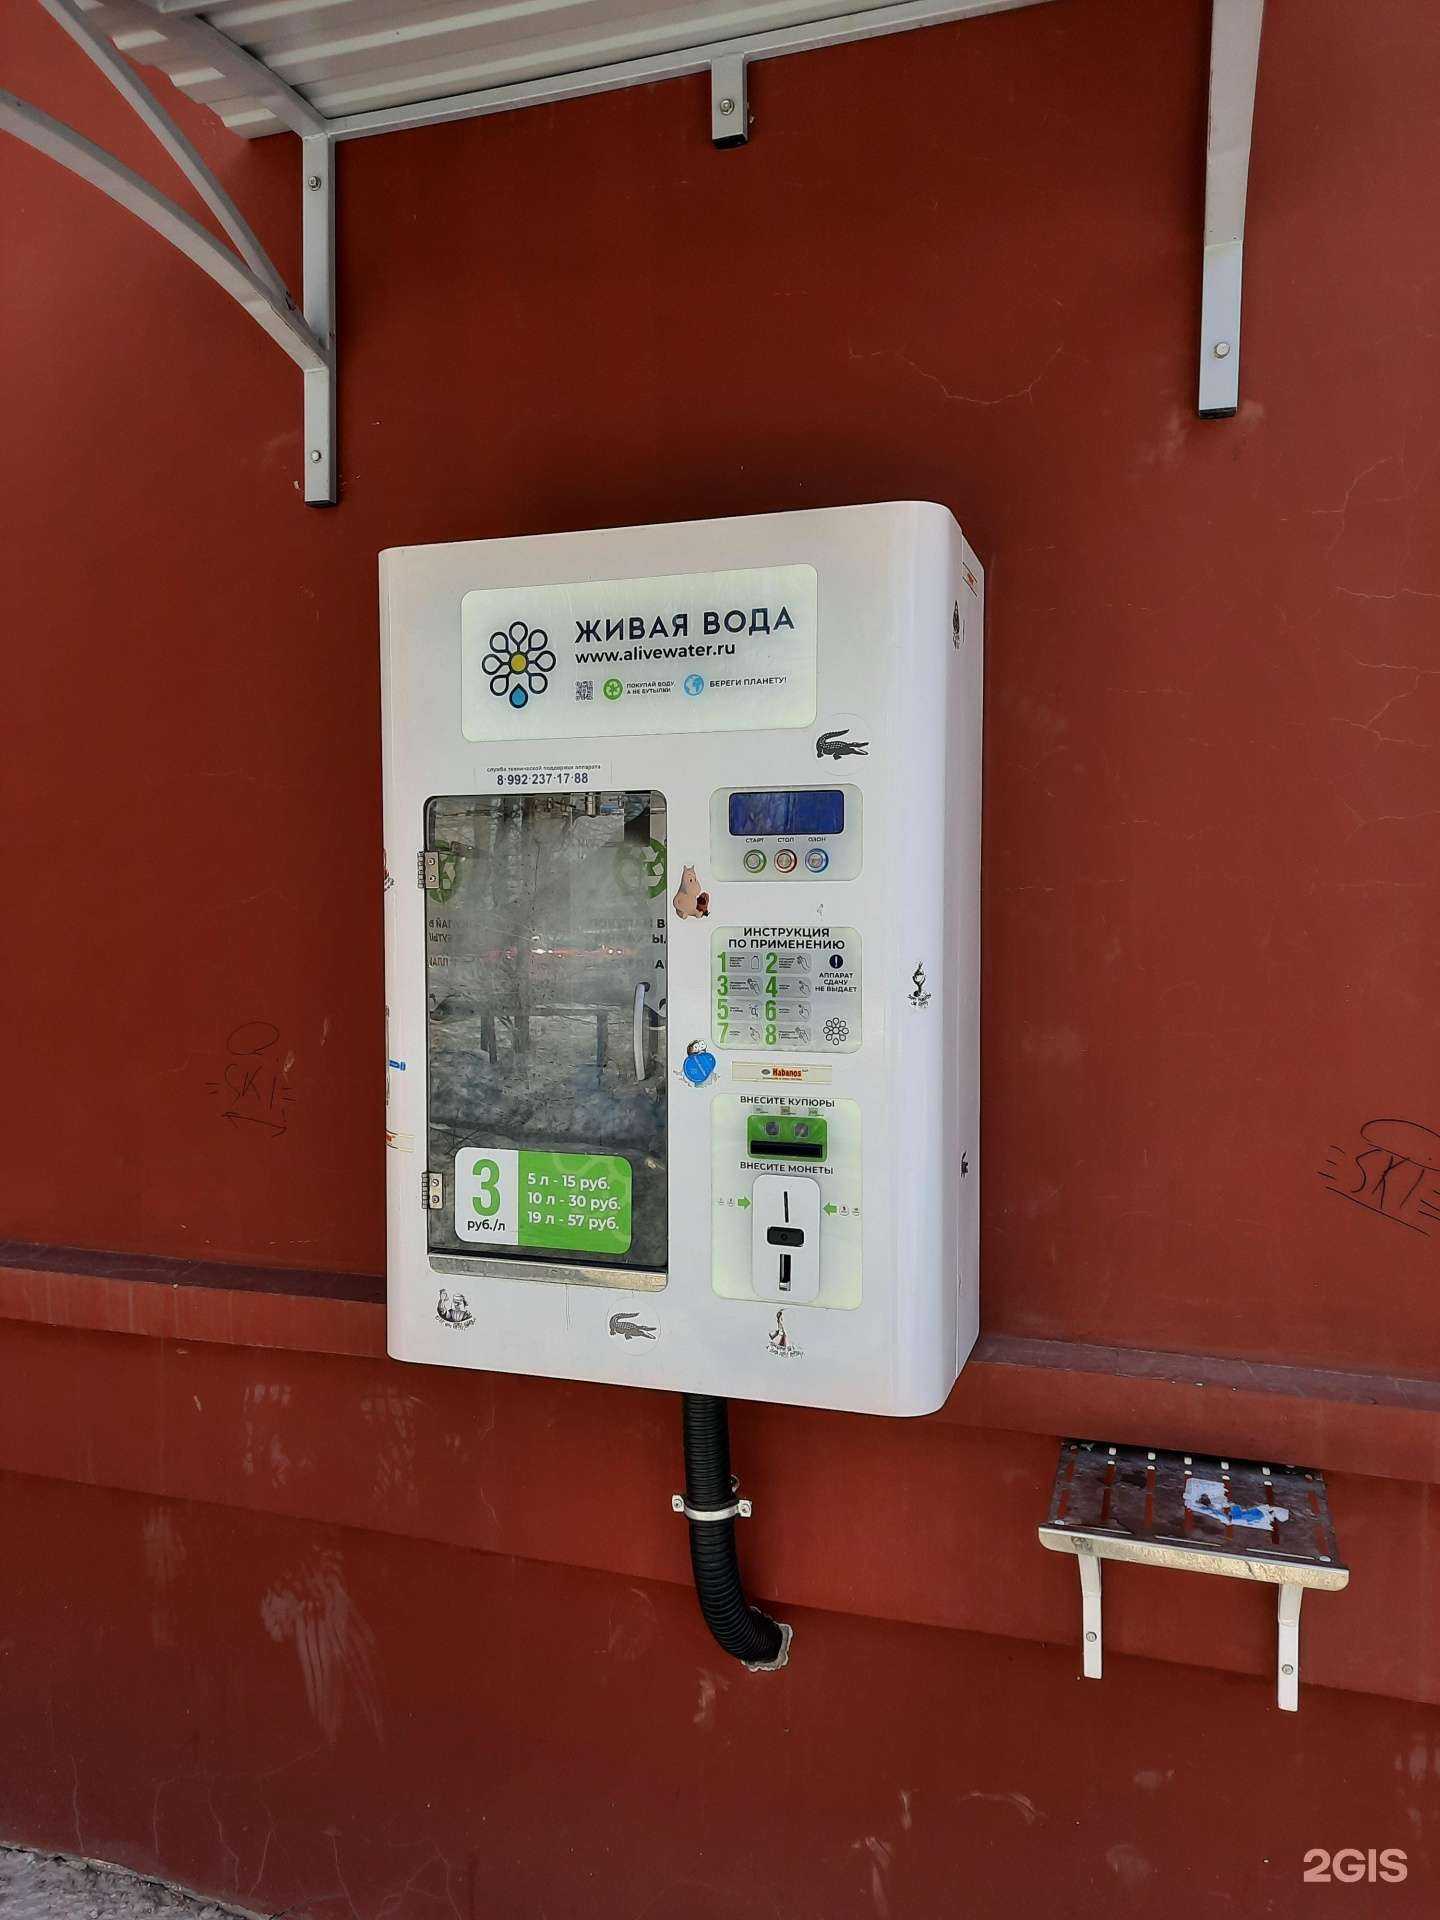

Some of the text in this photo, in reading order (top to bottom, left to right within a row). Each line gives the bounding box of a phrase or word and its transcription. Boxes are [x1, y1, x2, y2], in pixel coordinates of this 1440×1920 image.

[574, 606, 795, 643] ЖИВАЯ ВОДА
[575, 642, 736, 664] www.alivewater.ru
[626, 681, 656, 689] ПОКУПАЙ
[709, 677, 787, 688] БЕРЕГИ ПЛАНЕТУ!
[743, 927, 830, 939] ИНСТРУКЦИЯ
[728, 938, 845, 950] ПО ПРИМЕНЕНИЮ
[717, 952, 727, 973] 1
[765, 952, 778, 974] 2
[717, 975, 728, 996] 3
[765, 976, 778, 997] 4
[717, 999, 729, 1020] 5
[765, 1000, 777, 1021] 6
[717, 1022, 729, 1043] 7
[765, 1024, 777, 1045] 8
[772, 1068, 802, 1077] Habanos
[740, 1095, 835, 1107] ВНЕСИТЕ КУПЮРЫ
[740, 1161, 834, 1175] ВНЕСИТЕ МОНЕТЫ
[471, 1158, 501, 1216] 3
[527, 1173, 537, 1185] 5
[539, 1177, 549, 1186] л
[562, 1174, 577, 1187] 15
[580, 1177, 611, 1191] руб.
[527, 1192, 543, 1205] 10
[545, 1196, 555, 1206] л
[569, 1195, 587, 1208] 30
[590, 1197, 621, 1212] руб.
[467, 1218, 506, 1231] руб./л
[527, 1211, 542, 1224] 19
[545, 1216, 555, 1225] л
[567, 1214, 585, 1227] 57
[588, 1217, 620, 1231] руб.
